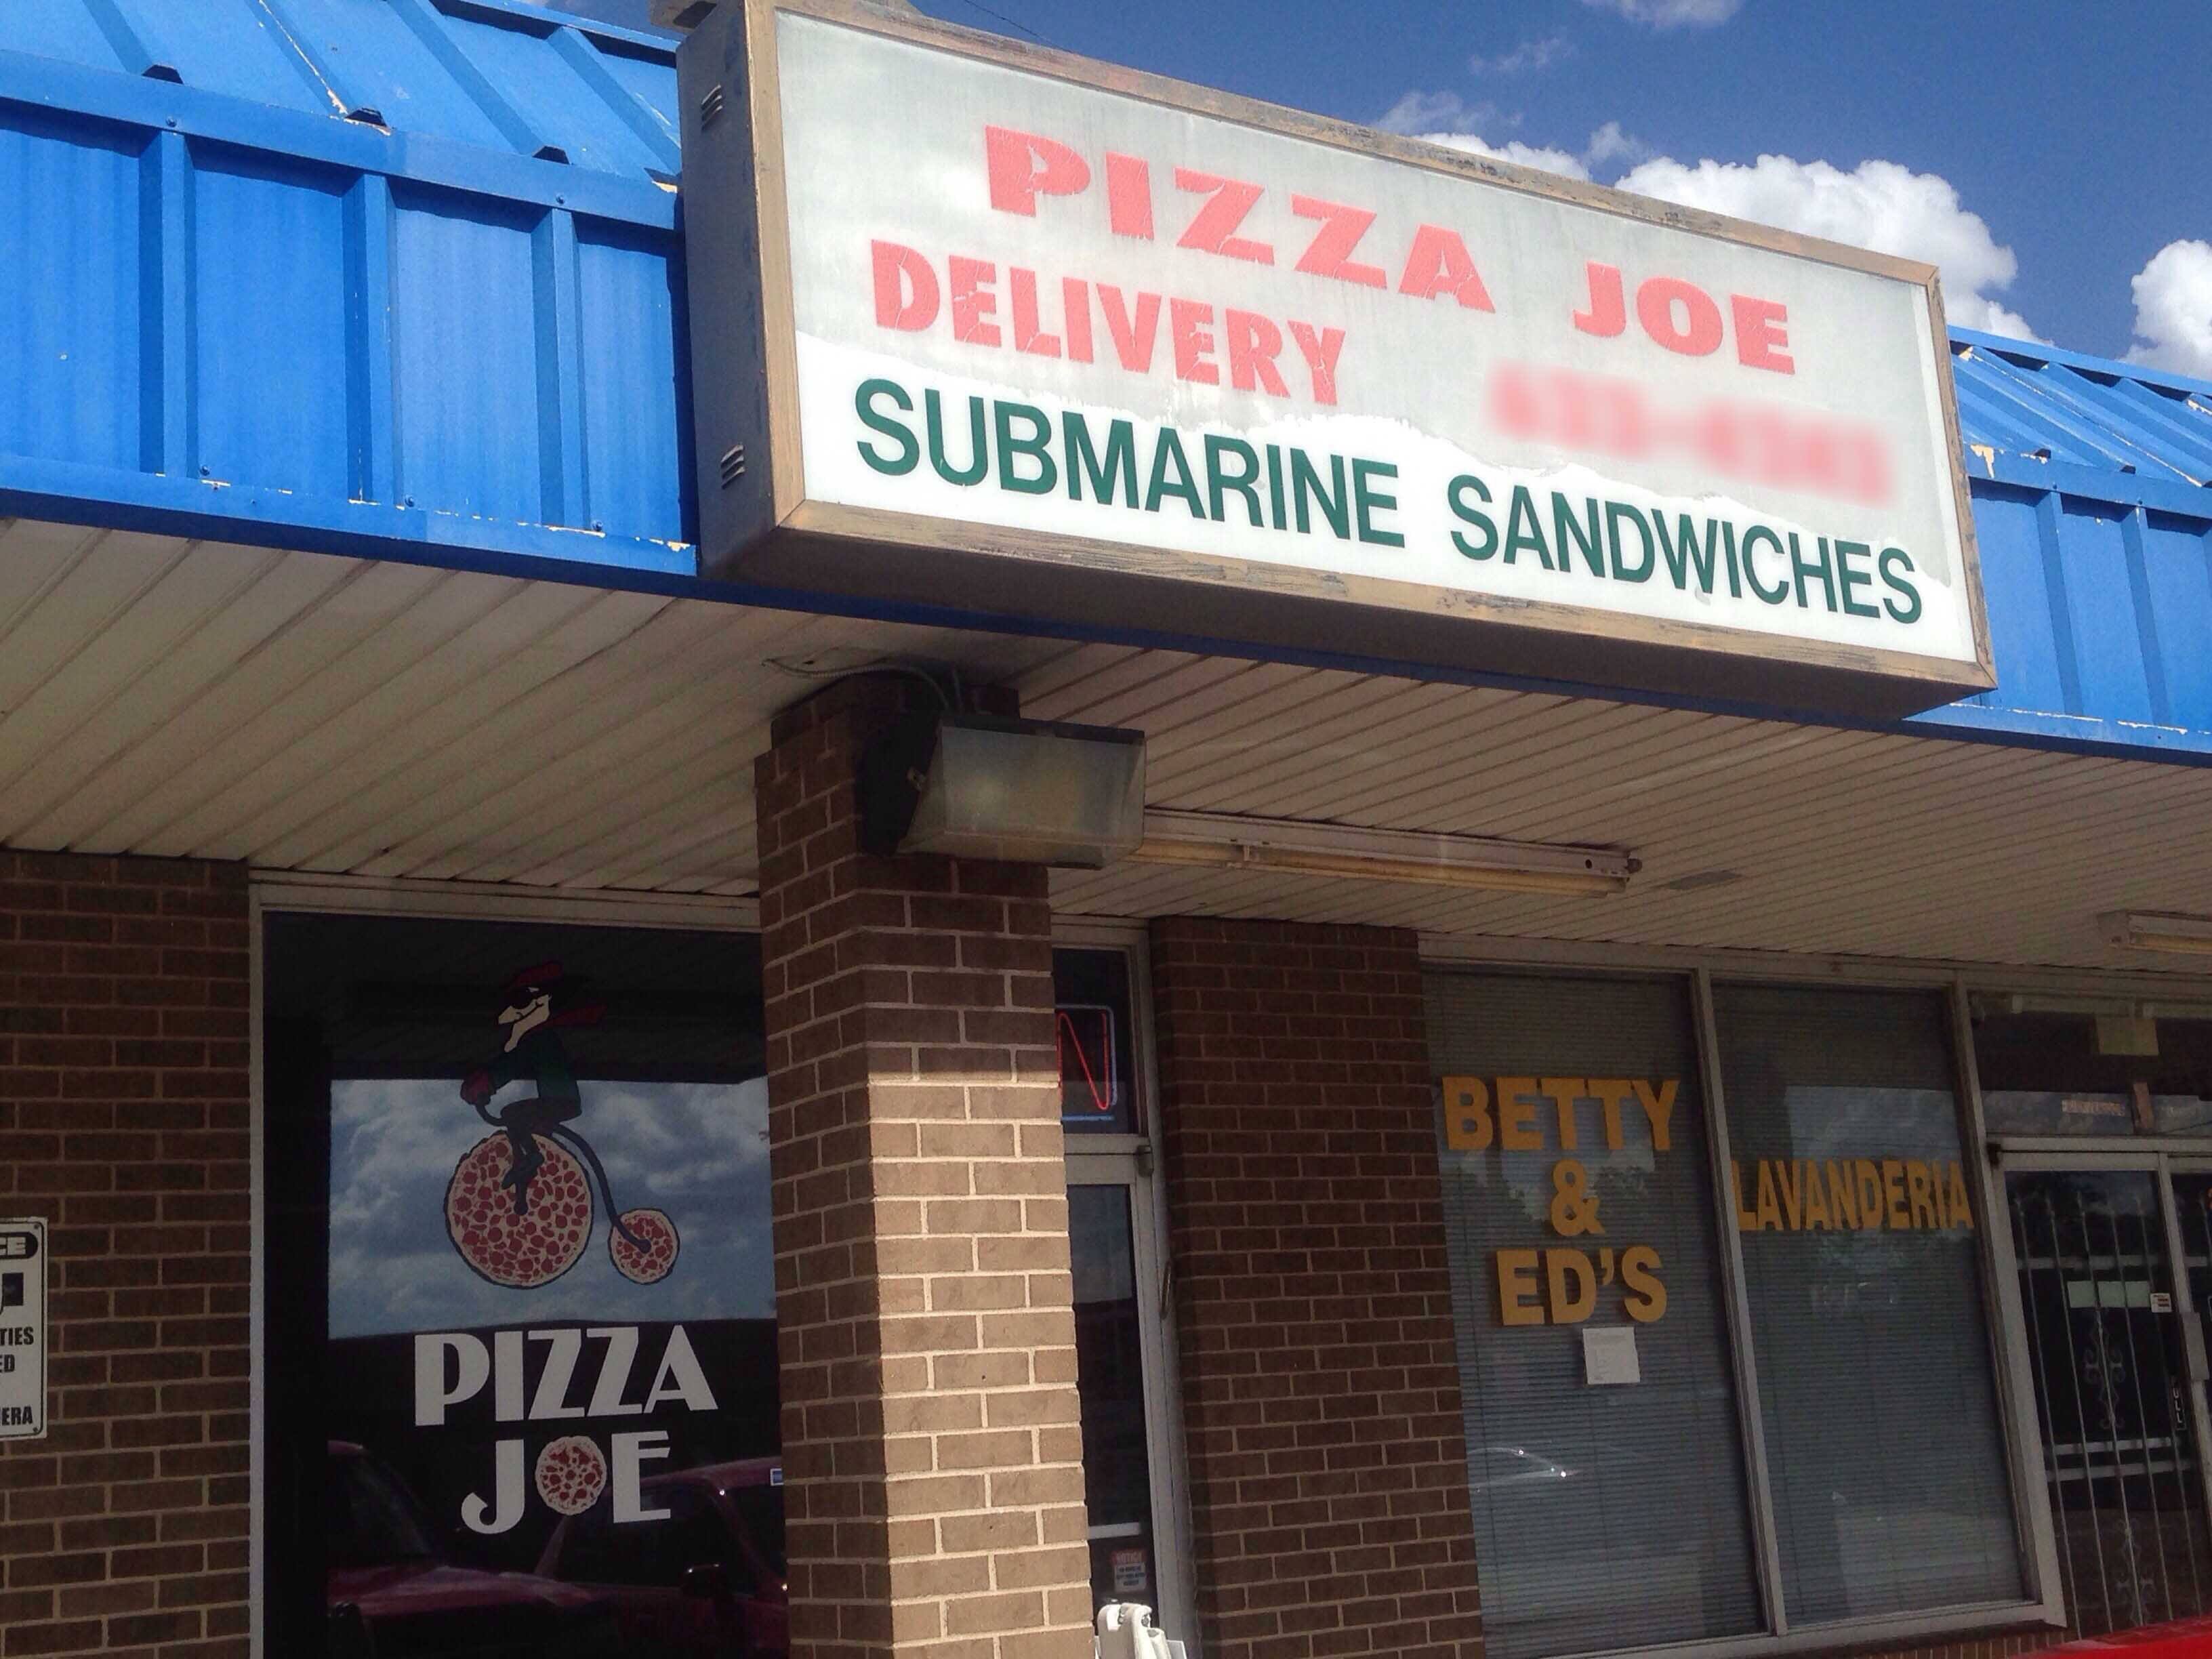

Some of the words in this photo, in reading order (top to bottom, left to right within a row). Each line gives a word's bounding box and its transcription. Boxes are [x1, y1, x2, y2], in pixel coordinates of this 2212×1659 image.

[984, 125, 1494, 312] PIZZA
[1572, 262, 1795, 375] JOE
[870, 239, 1346, 405] DELIVERY
[855, 377, 1405, 548] SUBMARINE
[1447, 474, 1922, 623] SANDWICHES
[1442, 1076, 1679, 1151] BETTY
[1550, 1158, 1605, 1237] &
[1732, 1158, 1975, 1231] LAVANDERIA
[1496, 1246, 1667, 1326] ED'S
[415, 1325, 718, 1426] PIZZA
